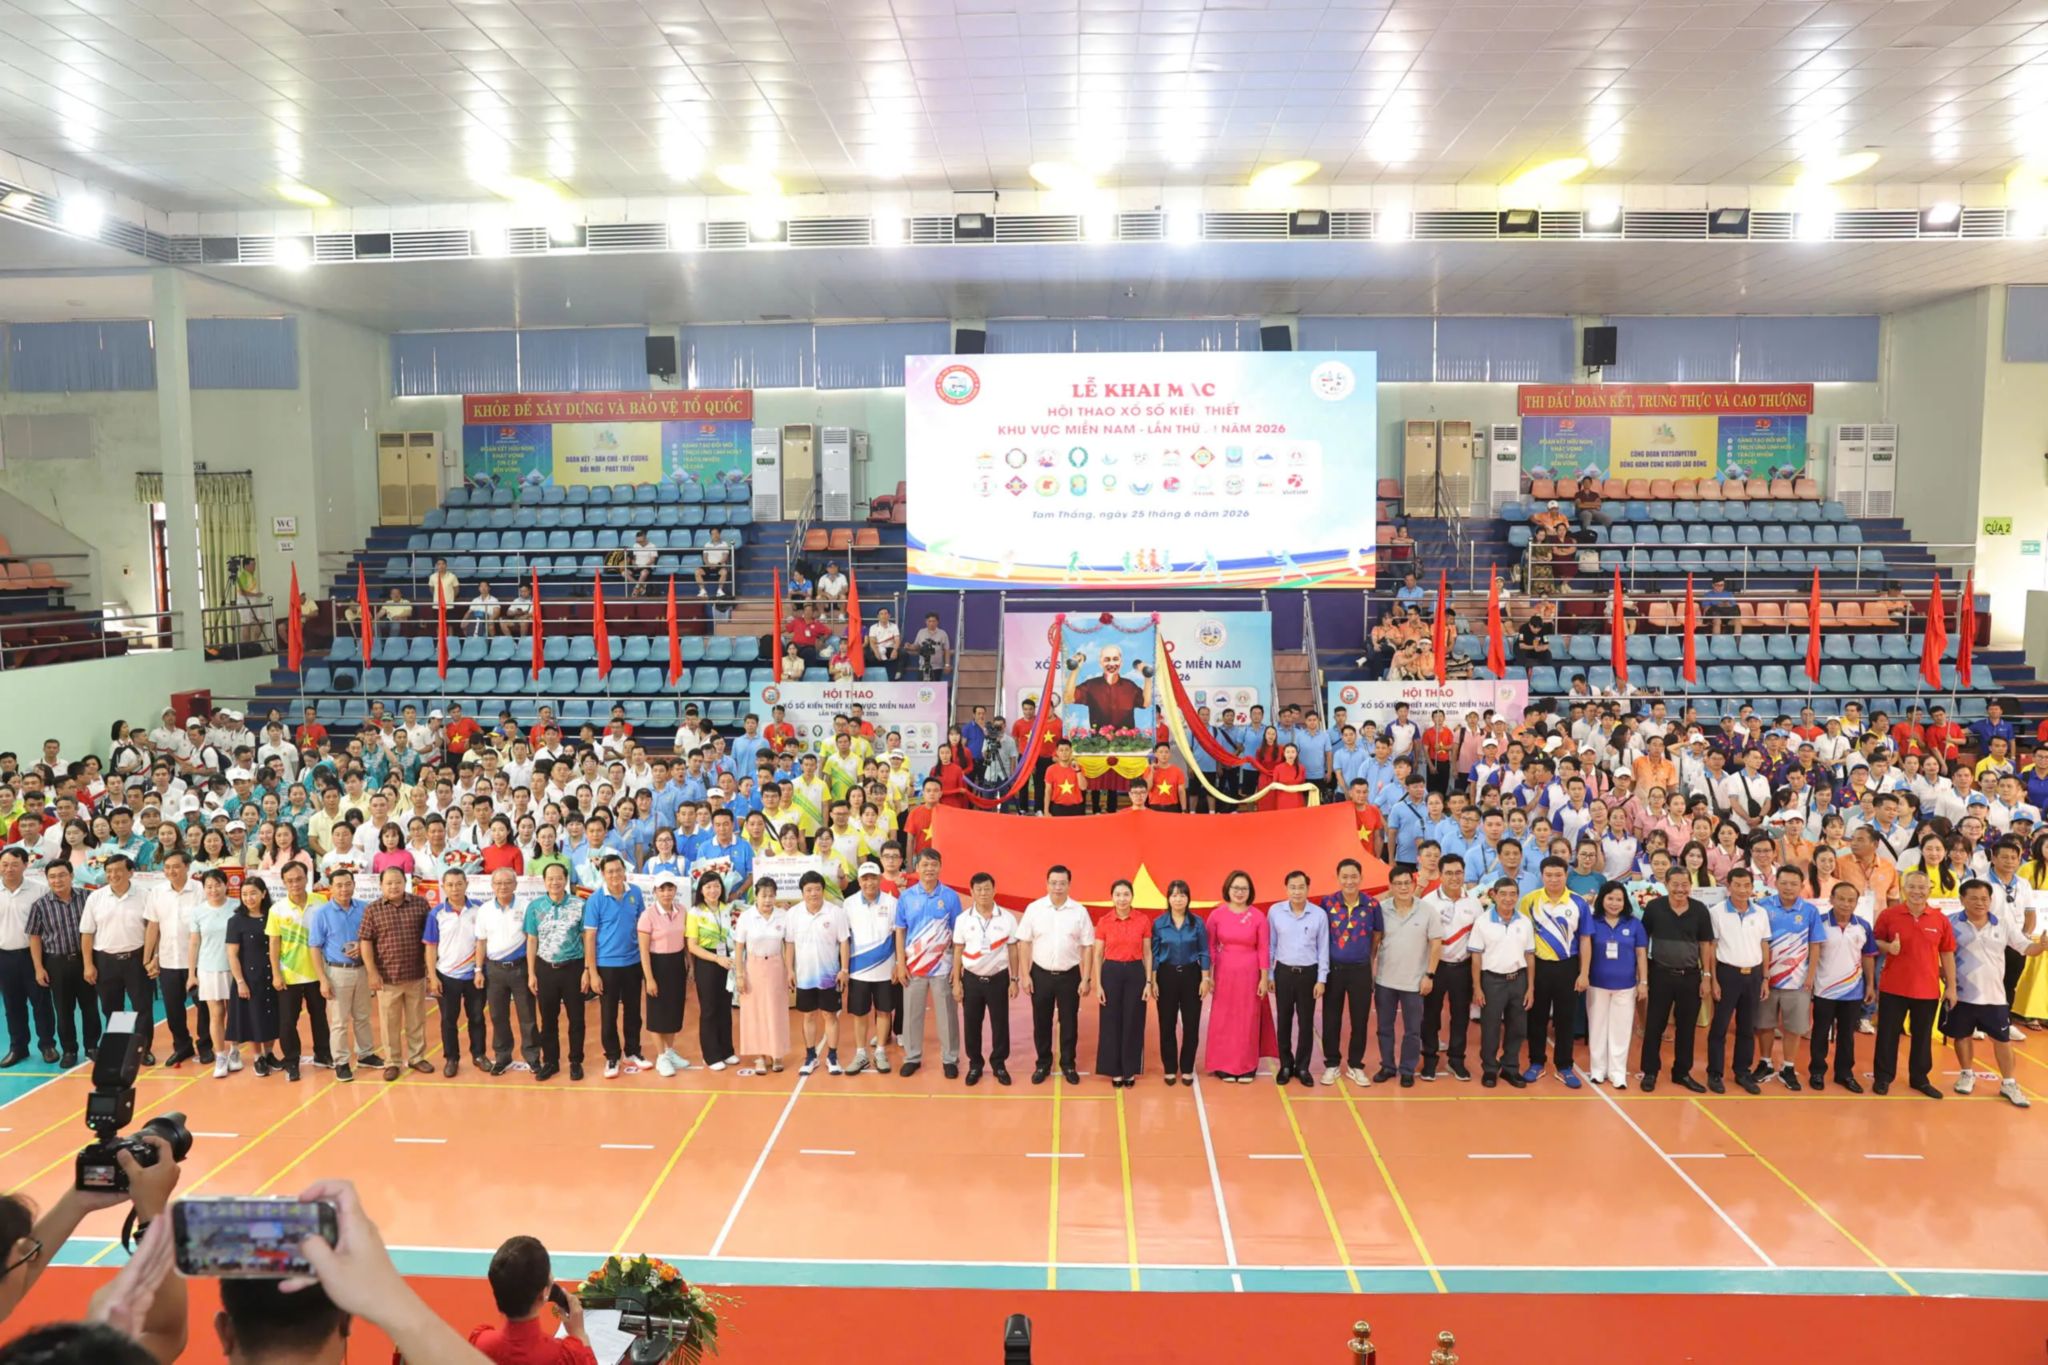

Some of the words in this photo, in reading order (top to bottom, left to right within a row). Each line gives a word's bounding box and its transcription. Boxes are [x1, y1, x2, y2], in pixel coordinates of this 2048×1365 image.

[1072, 376, 1097, 397] LỄ
[1104, 383, 1160, 397] KHAI
[1525, 395, 1544, 408] THI
[1548, 390, 1571, 408] ĐẤU
[1575, 392, 1606, 408] ĐOÀN
[1639, 394, 1676, 408] TRUNG
[1680, 392, 1712, 409] THỰC
[1715, 391, 1730, 407] VÀ
[1733, 394, 1756, 407] CAO
[1759, 392, 1807, 409] THƯỢNG
[474, 400, 511, 417] KHỎE
[514, 398, 532, 416] ĐỂ
[536, 400, 562, 416] XÂY
[566, 400, 603, 418] DỰNG
[607, 399, 624, 415] VÀ
[630, 397, 657, 414] BẢO
[661, 397, 678, 416] VỆ
[682, 395, 700, 413] TỔ
[704, 395, 742, 416] QUỐC
[1078, 406, 1116, 417] THAO
[1146, 402, 1165, 416] SỐ
[1205, 402, 1240, 416] THIẾT
[997, 425, 1026, 436] KHU
[1031, 424, 1060, 438] VỰC
[1065, 419, 1098, 435] MIỀN
[1103, 424, 1136, 435] NAM
[1221, 422, 1252, 434] NĂM
[1255, 424, 1287, 434] 2026
[1033, 510, 1054, 518] Tam
[1099, 510, 1127, 520] ngày
[1131, 510, 1145, 518] 25
[1222, 510, 1250, 518] 2026
[276, 519, 293, 528] WC
[2005, 523, 2011, 533] 2
[1186, 656, 1212, 669] MIỀN
[1216, 660, 1241, 669] NAM
[823, 688, 842, 700] HỘI
[846, 690, 874, 699] THAO
[1403, 687, 1421, 699] HỘI
[1426, 689, 1454, 698] THAO
[825, 701, 843, 709] THIẾT
[879, 700, 897, 709] MIỀN
